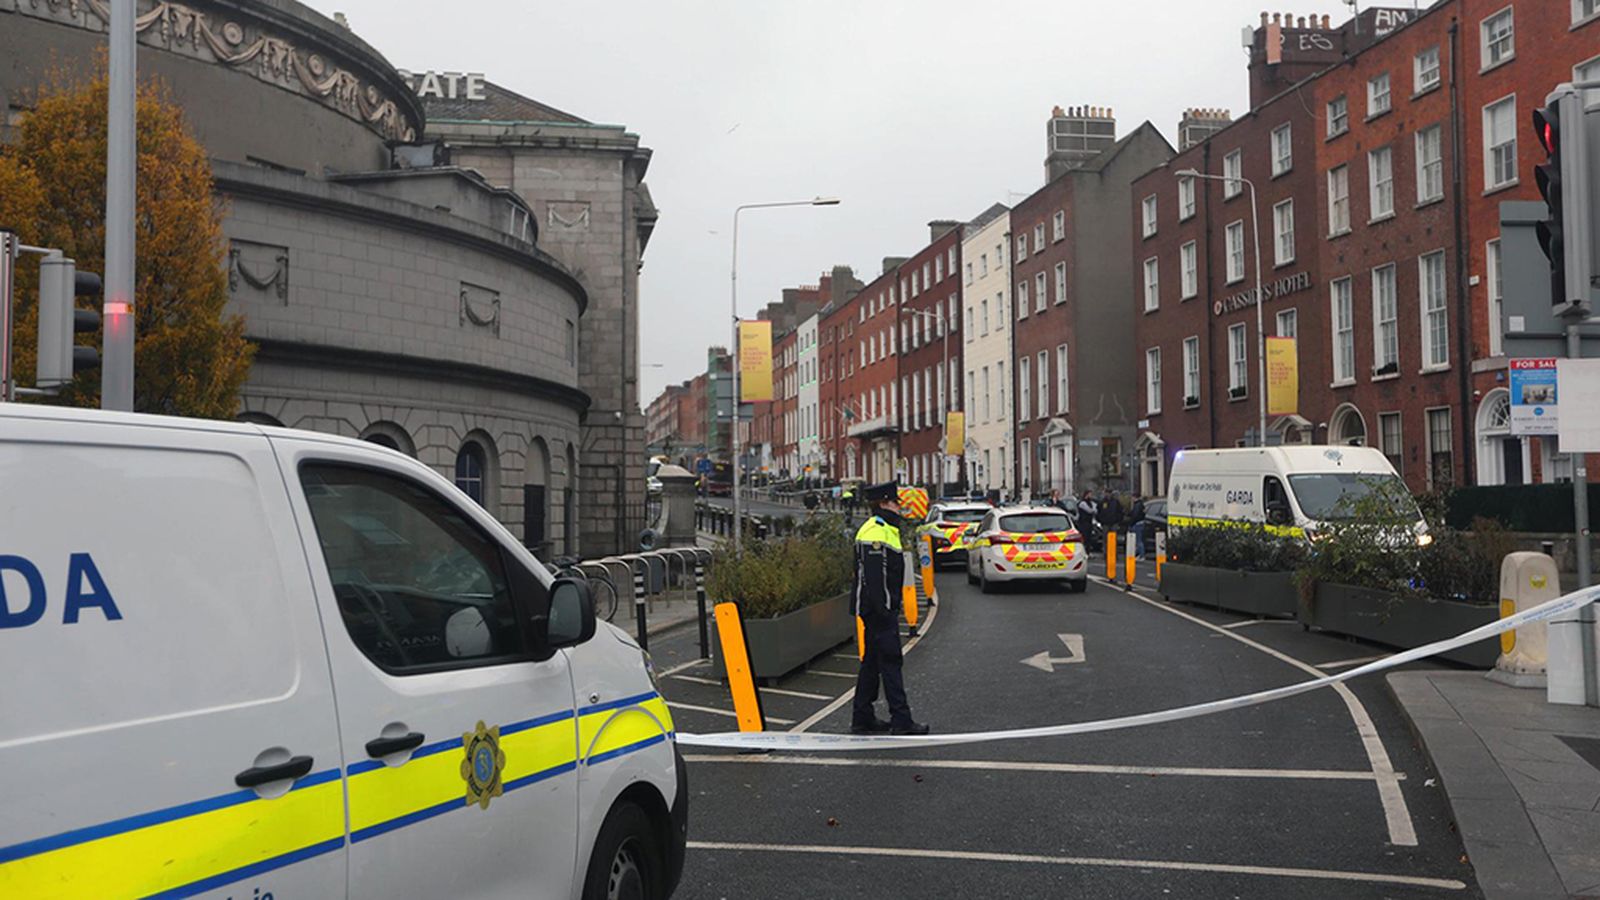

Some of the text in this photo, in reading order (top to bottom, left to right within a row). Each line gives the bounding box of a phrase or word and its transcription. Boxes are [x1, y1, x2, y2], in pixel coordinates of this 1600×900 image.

[1274, 271, 1312, 297] HOTEL
[1226, 490, 1253, 505] GARDA
[0, 552, 123, 629] DA
